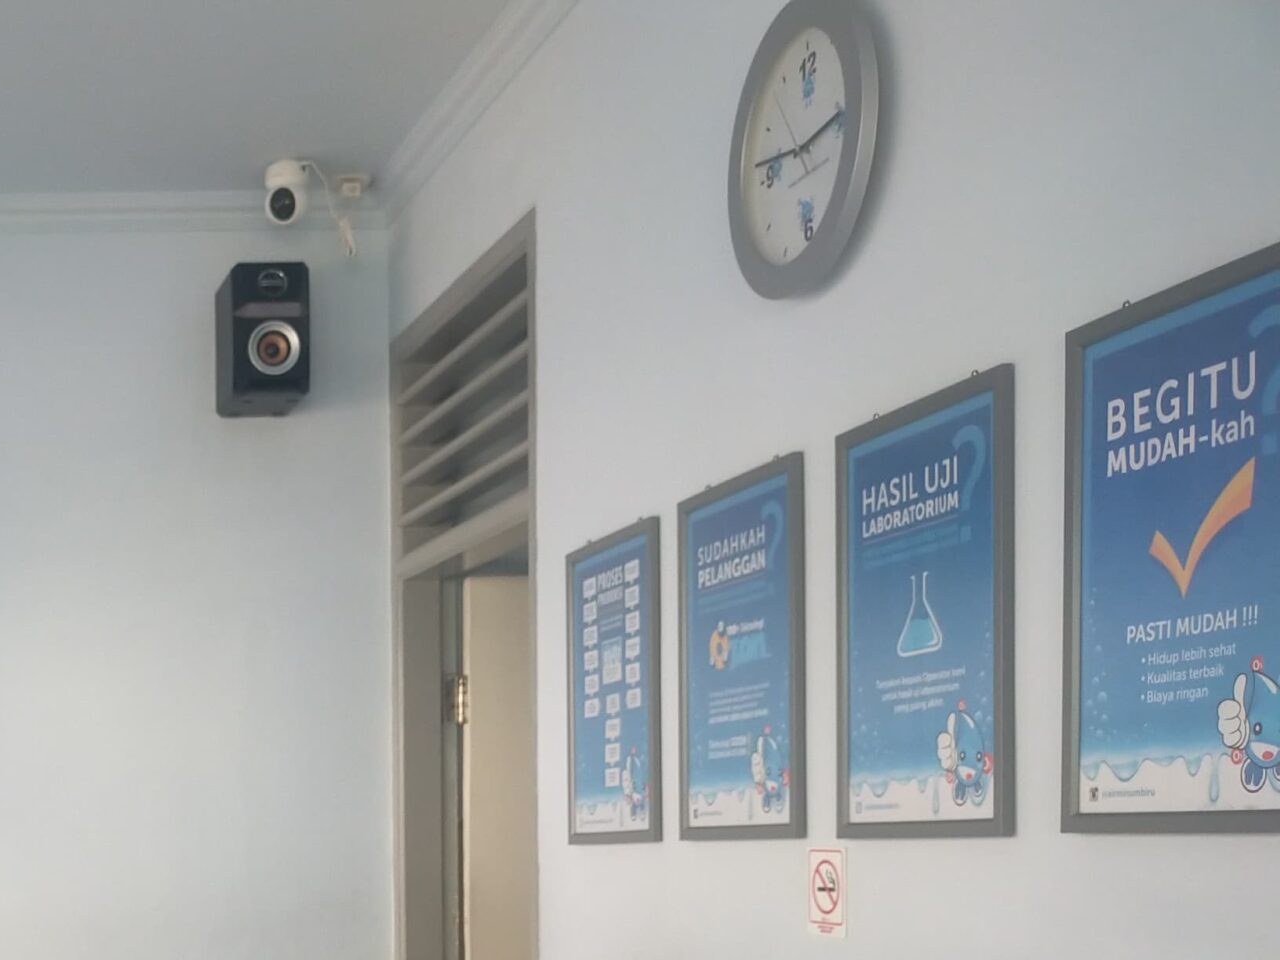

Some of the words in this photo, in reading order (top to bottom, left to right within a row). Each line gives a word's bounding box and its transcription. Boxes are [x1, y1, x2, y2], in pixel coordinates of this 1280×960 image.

[799, 51, 817, 82] 12
[1107, 350, 1257, 442] BEGITU
[1106, 409, 1256, 478] MUDAH-kah
[862, 471, 919, 516] HASIL
[924, 455, 958, 494] UJI
[862, 490, 959, 538] LABORATORIUM
[697, 523, 766, 567] SUDAHKAH
[697, 548, 766, 590] PELANGGAN
[1126, 619, 1172, 645] PASTI
[1175, 608, 1238, 638] MUDAH
[1241, 604, 1259, 627] !!!
[1146, 670, 1187, 685] Kualitas
[1189, 663, 1225, 679] terbaik
[1147, 652, 1179, 666] Hidup
[1181, 647, 1207, 661] lebih
[1208, 643, 1236, 658] sehat
[1146, 690, 1174, 705] Biaya
[1176, 687, 1209, 702] ringan
